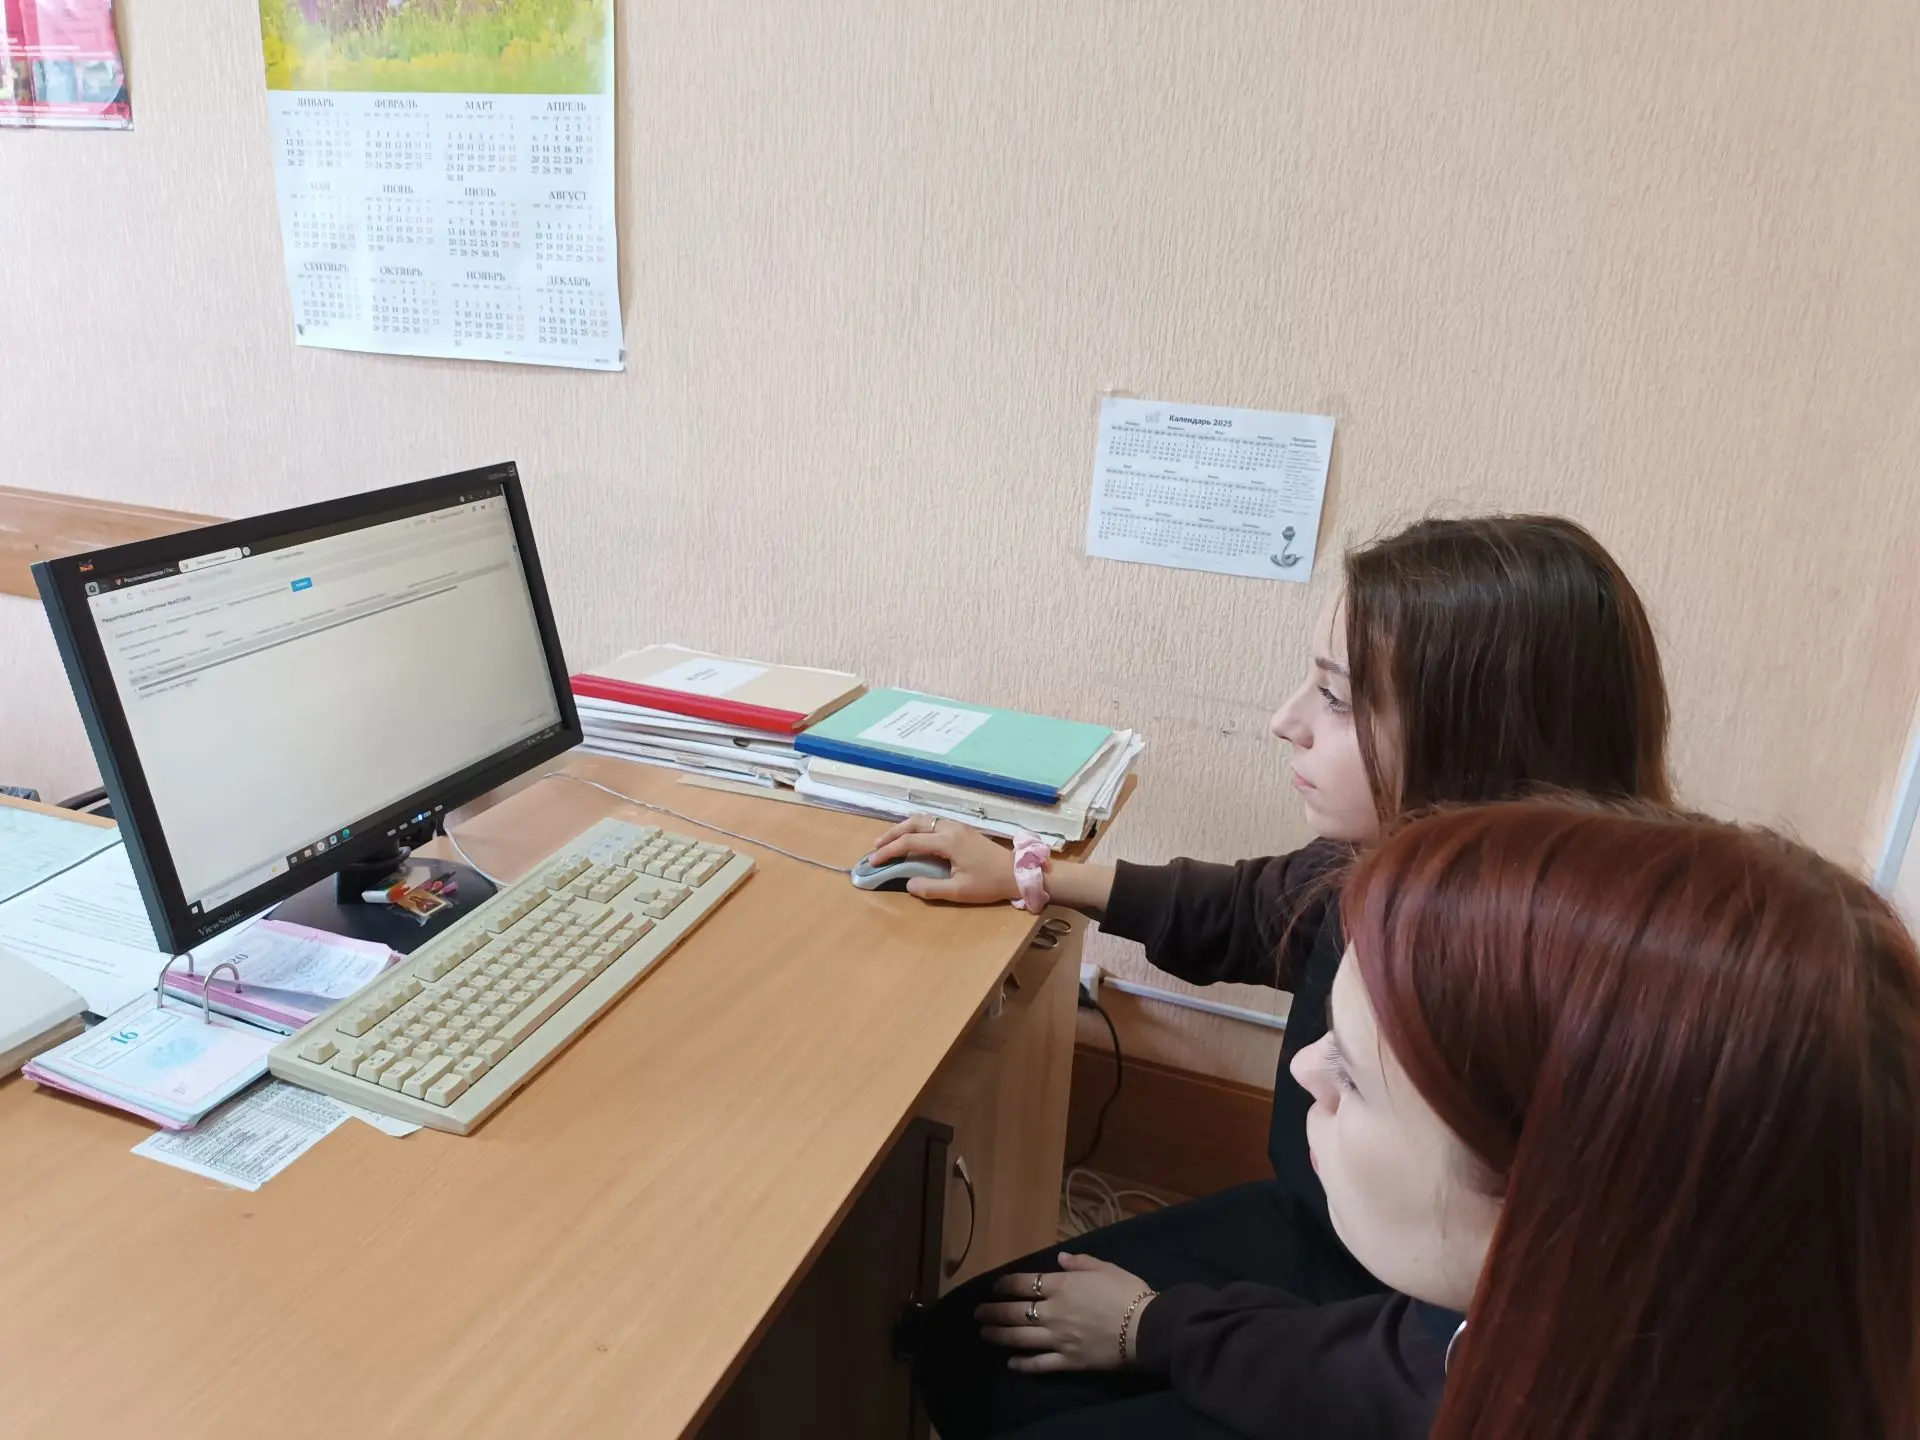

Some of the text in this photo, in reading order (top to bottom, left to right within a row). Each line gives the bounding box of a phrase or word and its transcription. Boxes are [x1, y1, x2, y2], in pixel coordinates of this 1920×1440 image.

[374, 99, 418, 109] ФЕВРАЛЬ
[465, 100, 495, 110] МАРТ
[547, 102, 587, 111] АПРЕЛЬ
[383, 184, 414, 194] ИЮНЬ
[464, 187, 497, 197] ИЮЛЬ
[549, 191, 586, 201] АВГУСТ
[380, 267, 423, 277] ОКТЯБРЬ
[466, 271, 506, 281] НОЯБРЬ
[547, 275, 591, 287] ДЕКАБРЬ
[1168, 414, 1233, 429] Календарь 2025
[197, 910, 242, 936] ViewSonic
[111, 1030, 138, 1045] 16
